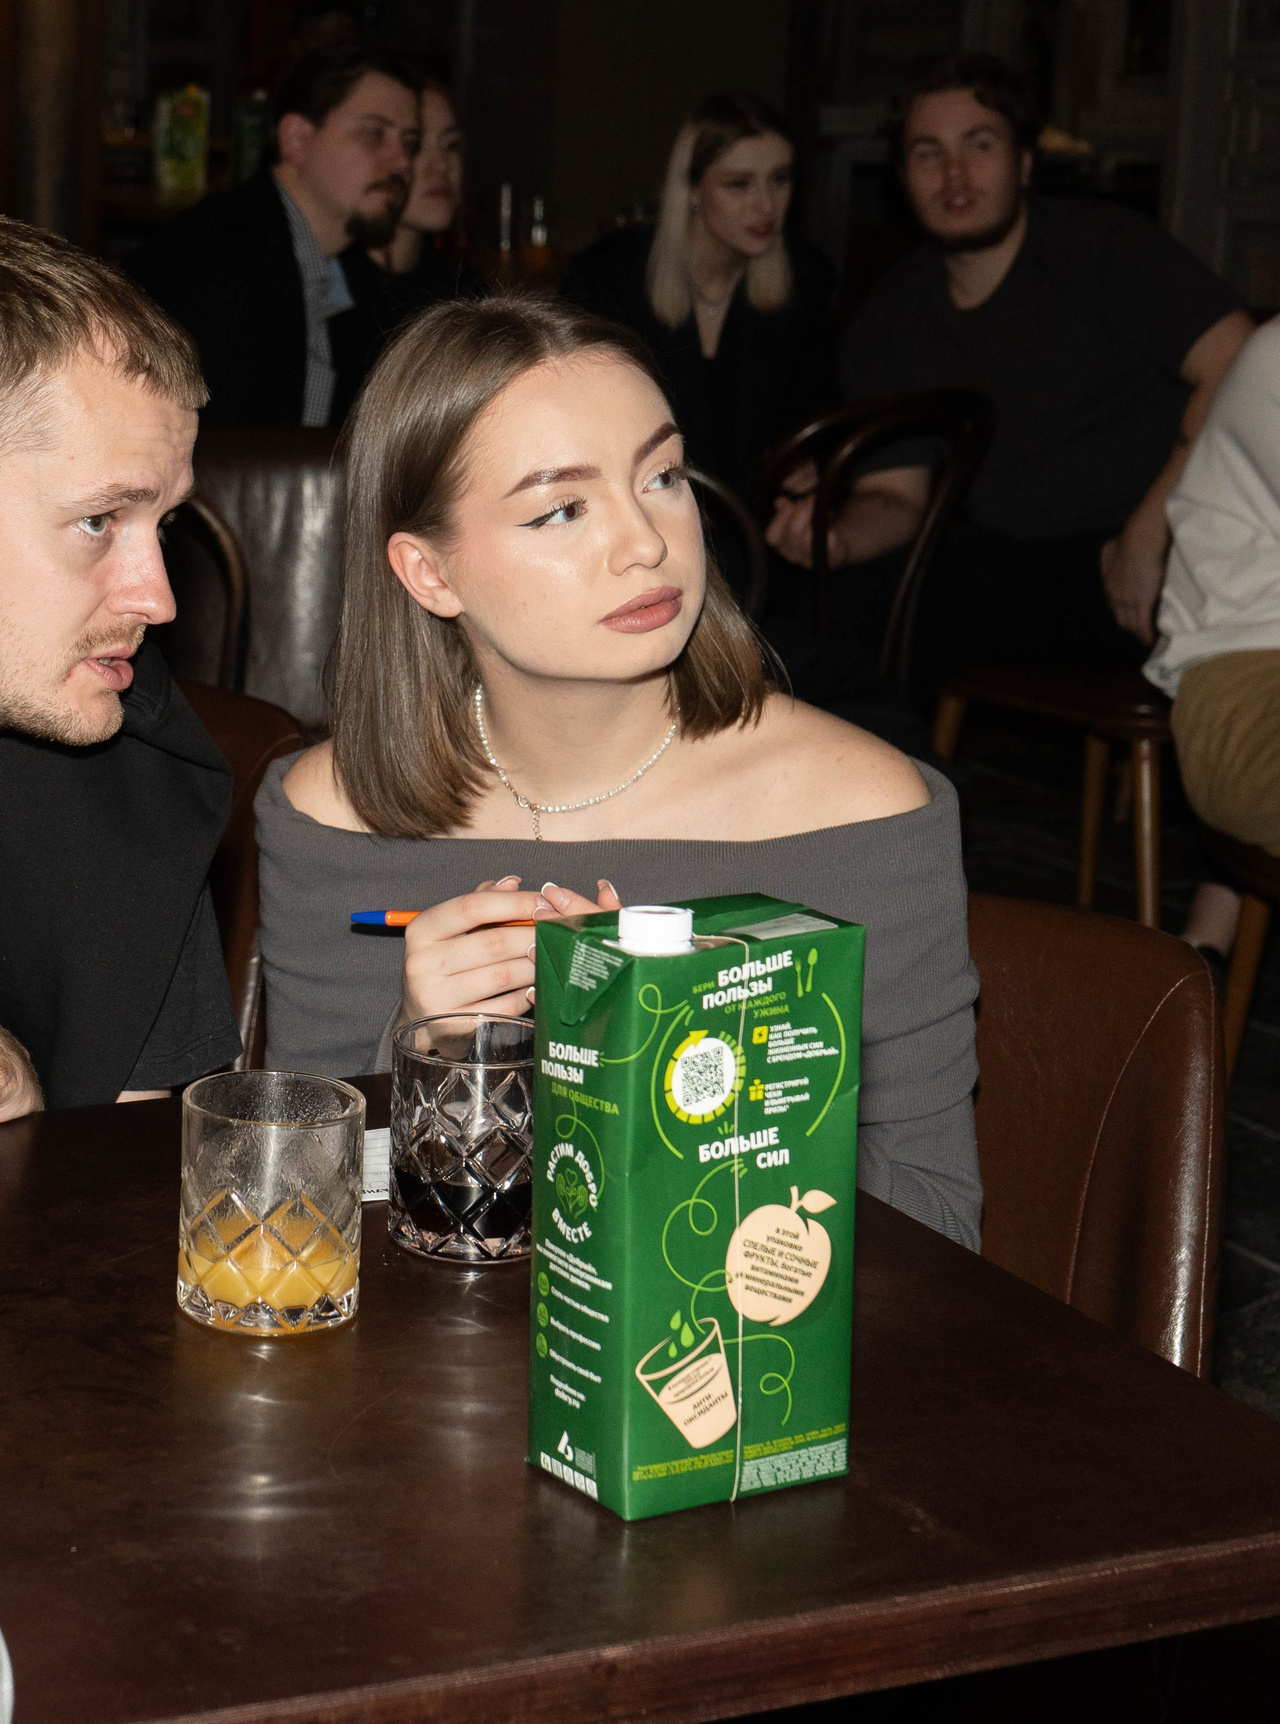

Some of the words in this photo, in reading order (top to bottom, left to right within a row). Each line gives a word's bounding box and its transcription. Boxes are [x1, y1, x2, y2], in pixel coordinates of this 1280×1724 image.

[717, 950, 793, 988] БОЛЬШЕ
[702, 977, 773, 1010] ПОЛЬЗЫ
[724, 1003, 736, 1014] ОТ
[753, 1004, 790, 1019] УЖИНА
[548, 1041, 600, 1068] БОЛЬШЕ
[541, 1059, 584, 1085] ПОЛЬЗЫ
[551, 1082, 568, 1098] ДЛЯ
[568, 1089, 619, 1115] ОБЩЕСТВА
[698, 1126, 780, 1163] БОЛЬШЕ
[756, 1148, 790, 1169] СИЛ
[546, 1142, 574, 1183] РАСТИМ
[574, 1150, 598, 1208] ДОБРО
[551, 1207, 593, 1244] ВМЕСТЕ
[742, 1239, 777, 1256] СПЕЛЫЕ
[784, 1252, 819, 1269] СОЧНЫЕ
